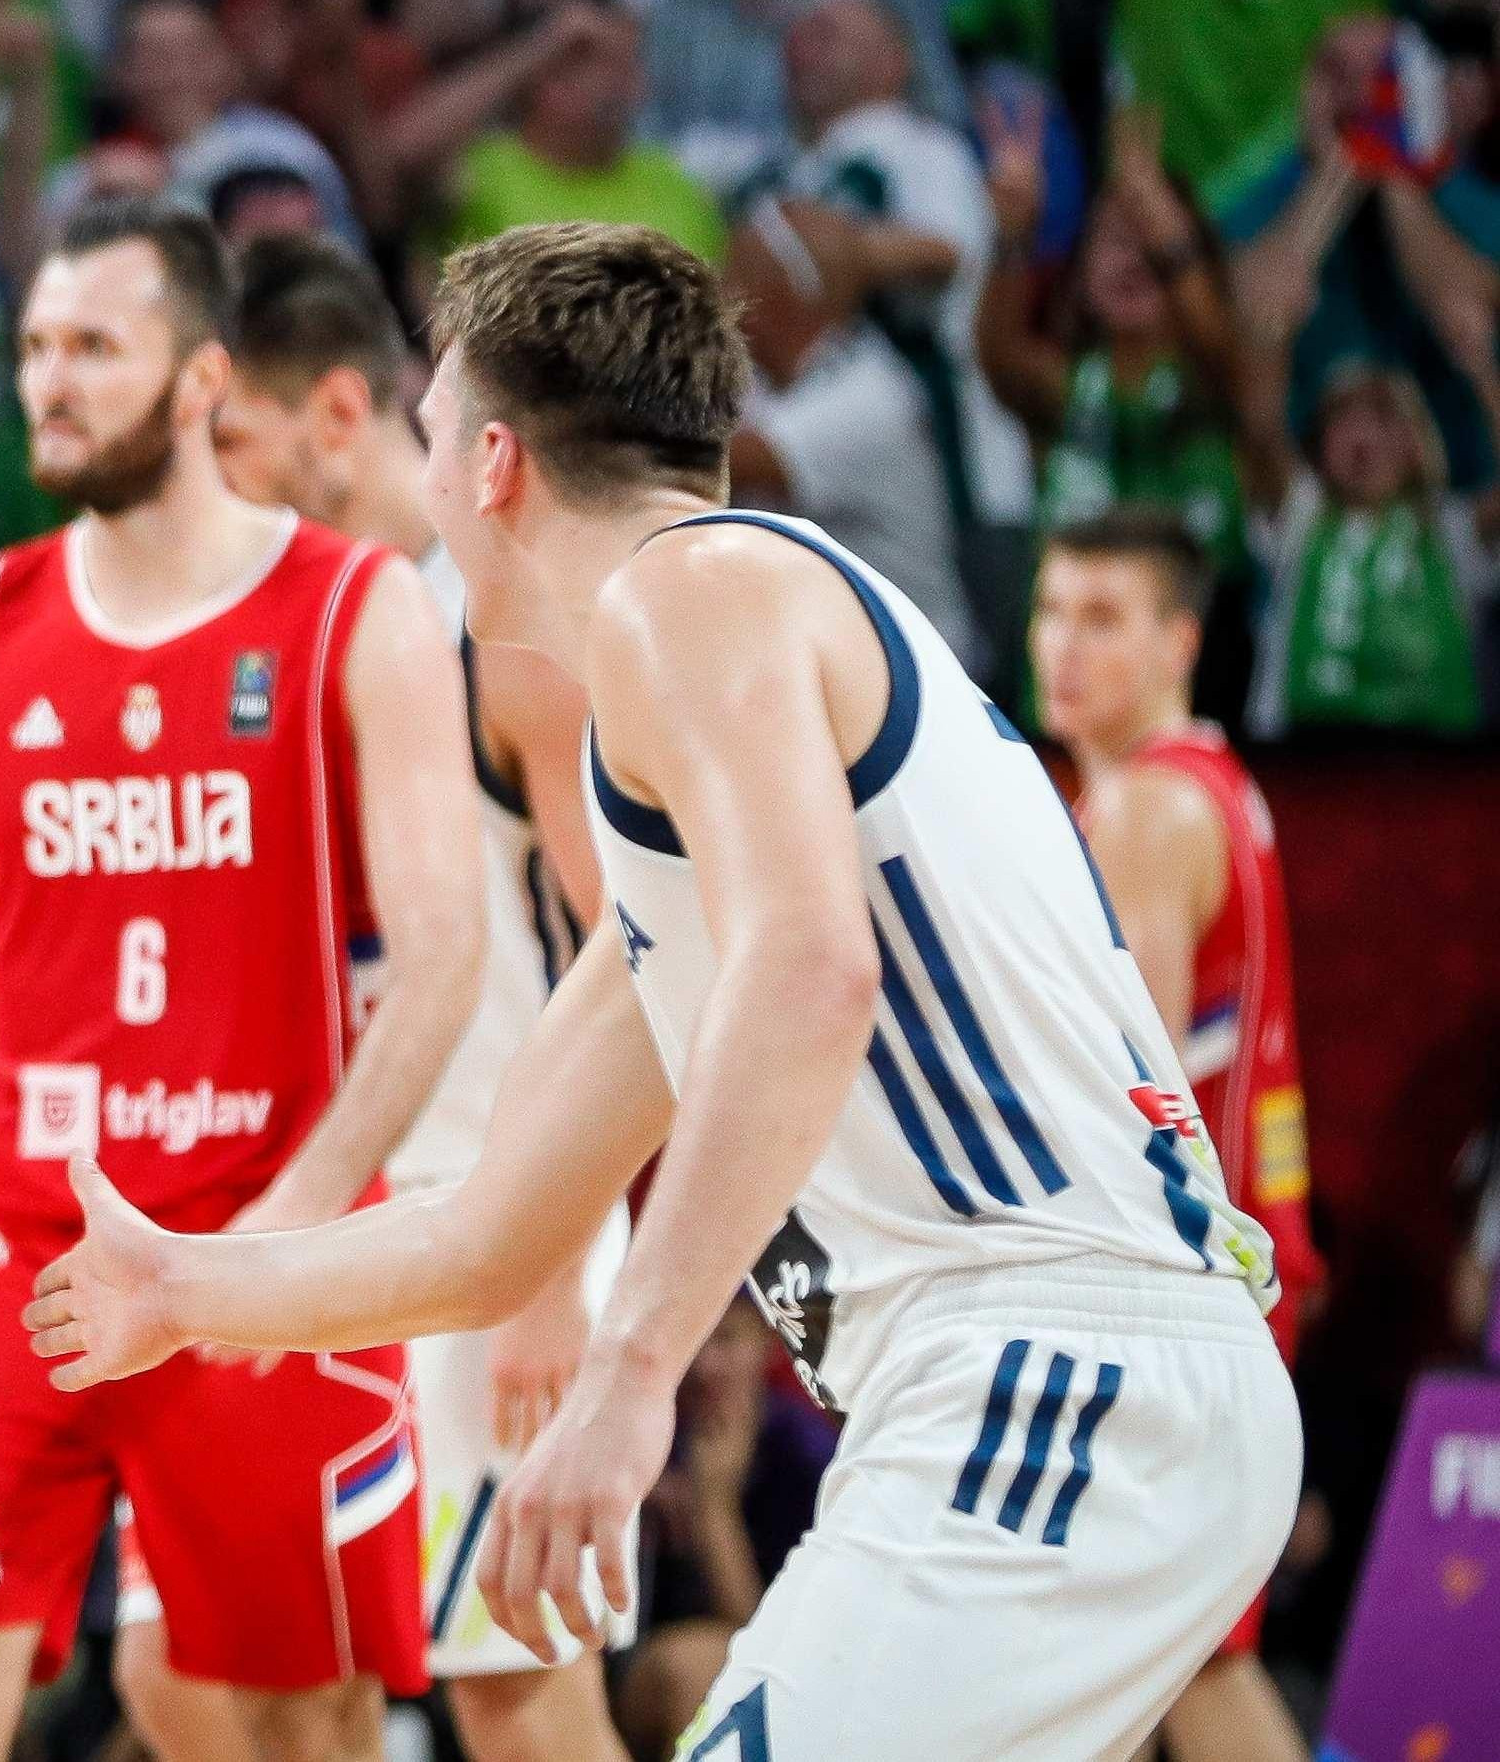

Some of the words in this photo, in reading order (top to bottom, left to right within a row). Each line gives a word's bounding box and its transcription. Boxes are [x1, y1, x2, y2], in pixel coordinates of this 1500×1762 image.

[22, 769, 253, 877] SRBIJA
[117, 915, 168, 1026] 6
[103, 1077, 274, 1155] triglav
